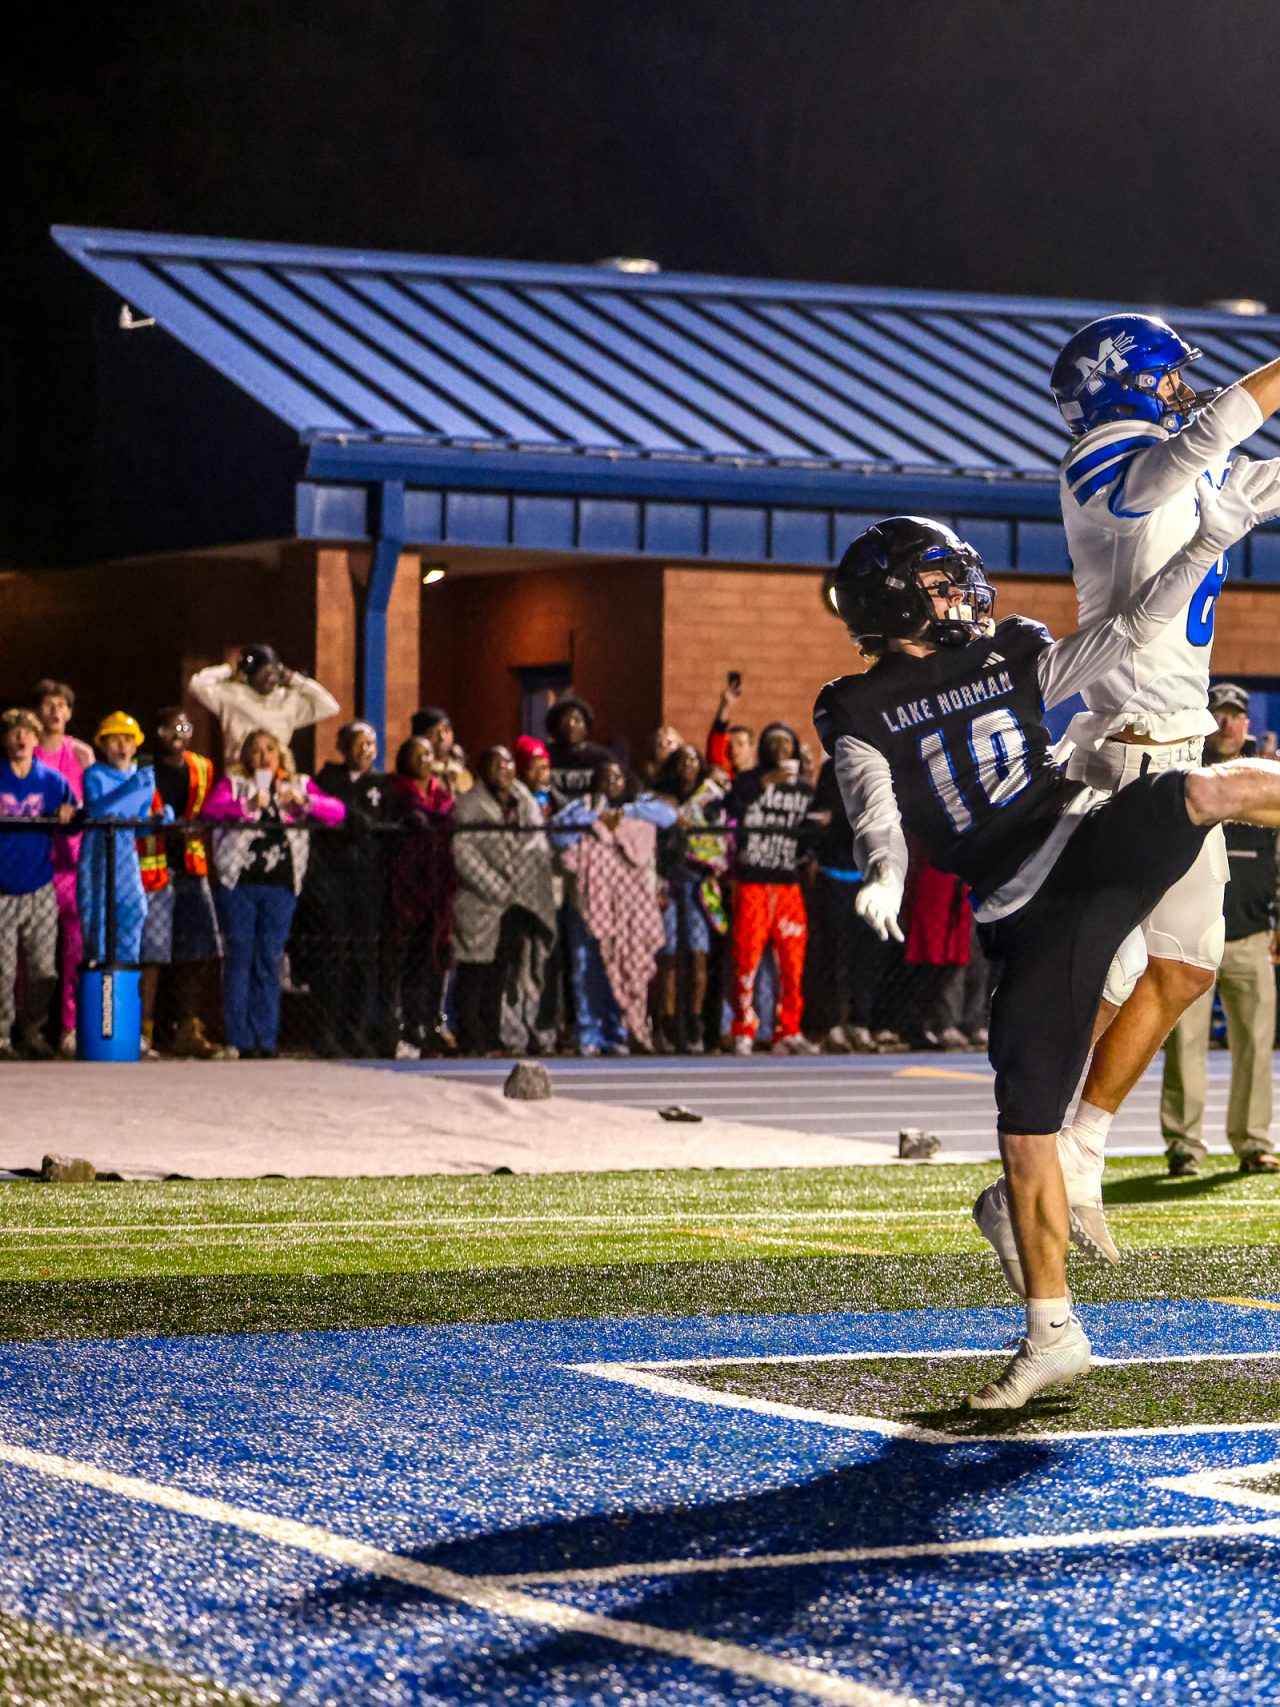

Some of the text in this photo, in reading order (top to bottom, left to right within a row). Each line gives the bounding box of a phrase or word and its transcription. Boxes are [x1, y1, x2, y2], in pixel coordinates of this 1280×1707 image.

[881, 671, 1015, 733] LAKE NORMAN
[916, 707, 1032, 836] 10
